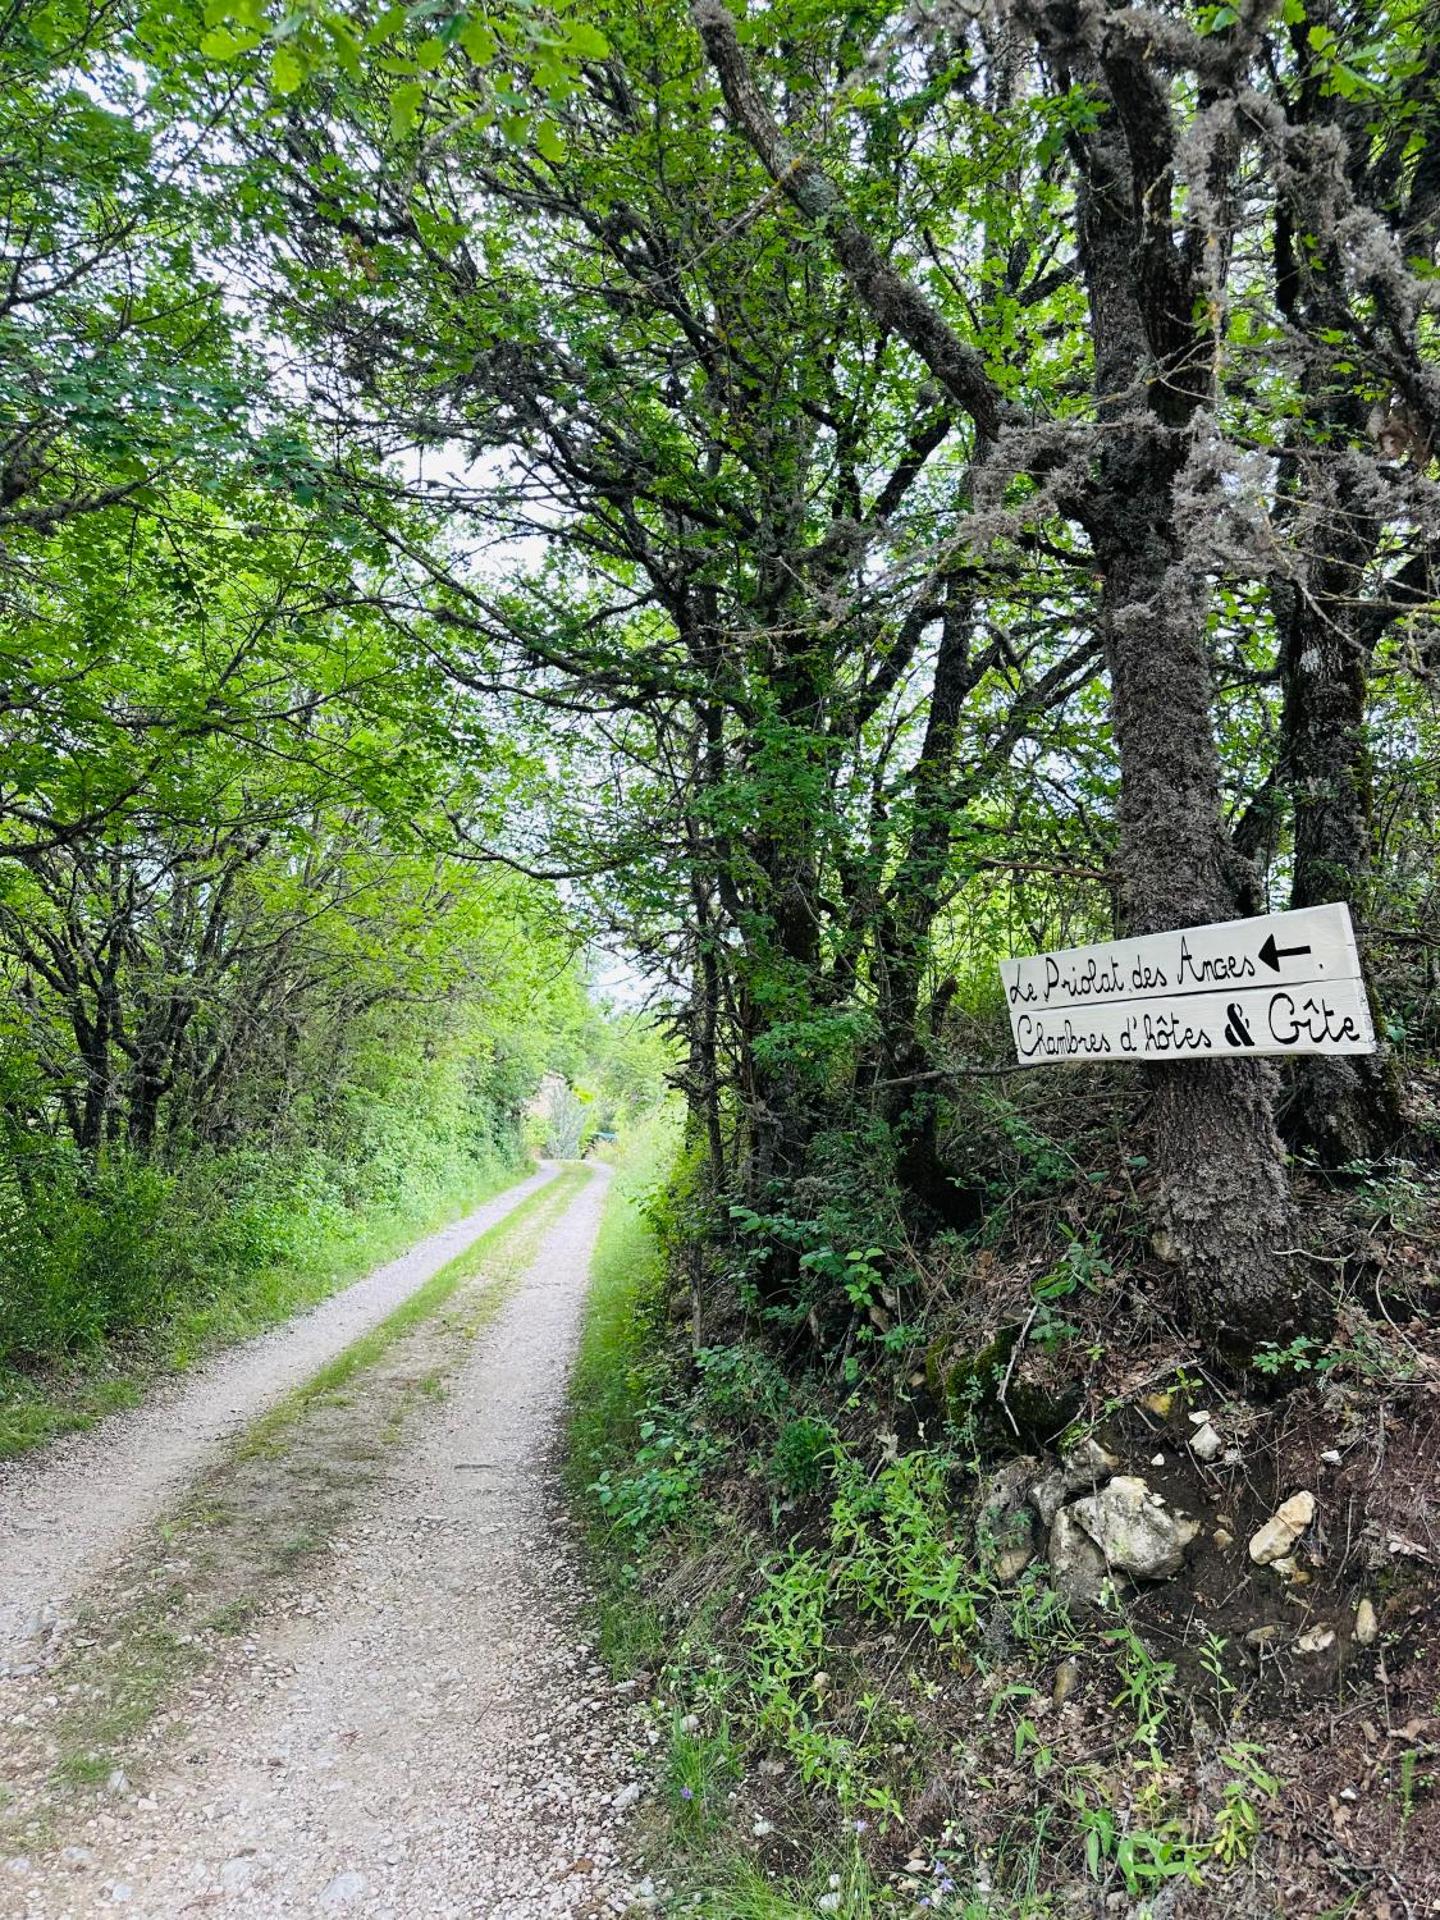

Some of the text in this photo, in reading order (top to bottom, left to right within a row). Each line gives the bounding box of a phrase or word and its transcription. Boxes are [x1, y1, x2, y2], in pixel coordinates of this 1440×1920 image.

[1010, 963, 1037, 1004] Le
[1042, 957, 1125, 1002] Priolat
[1132, 954, 1167, 990] des
[1017, 992, 1360, 1056] Chambres d'hôtes & Gîte
